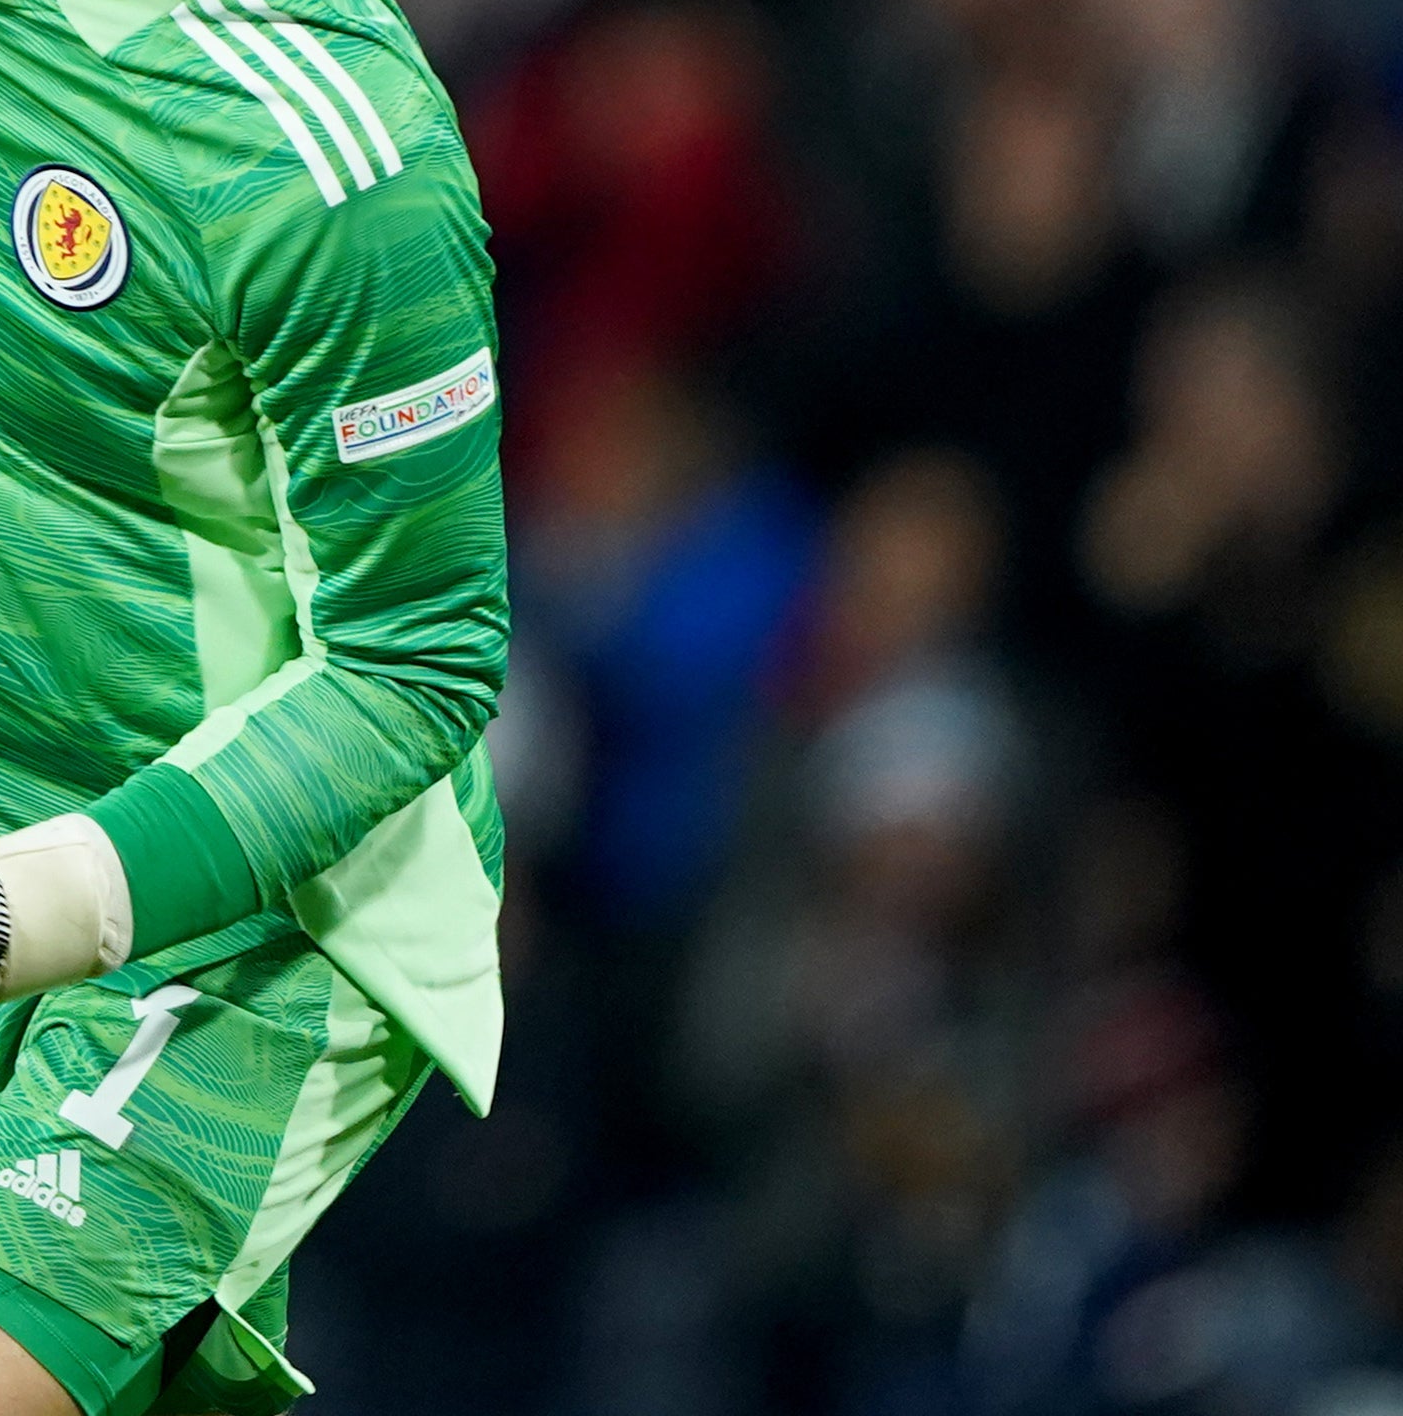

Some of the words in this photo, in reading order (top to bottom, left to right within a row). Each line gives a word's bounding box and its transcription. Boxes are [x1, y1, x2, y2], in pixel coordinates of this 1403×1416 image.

[58, 174, 109, 215] SCOTLAND
[339, 405, 378, 423] UEFA
[340, 367, 489, 442] FOUNDATION
[58, 984, 203, 1151] 1
